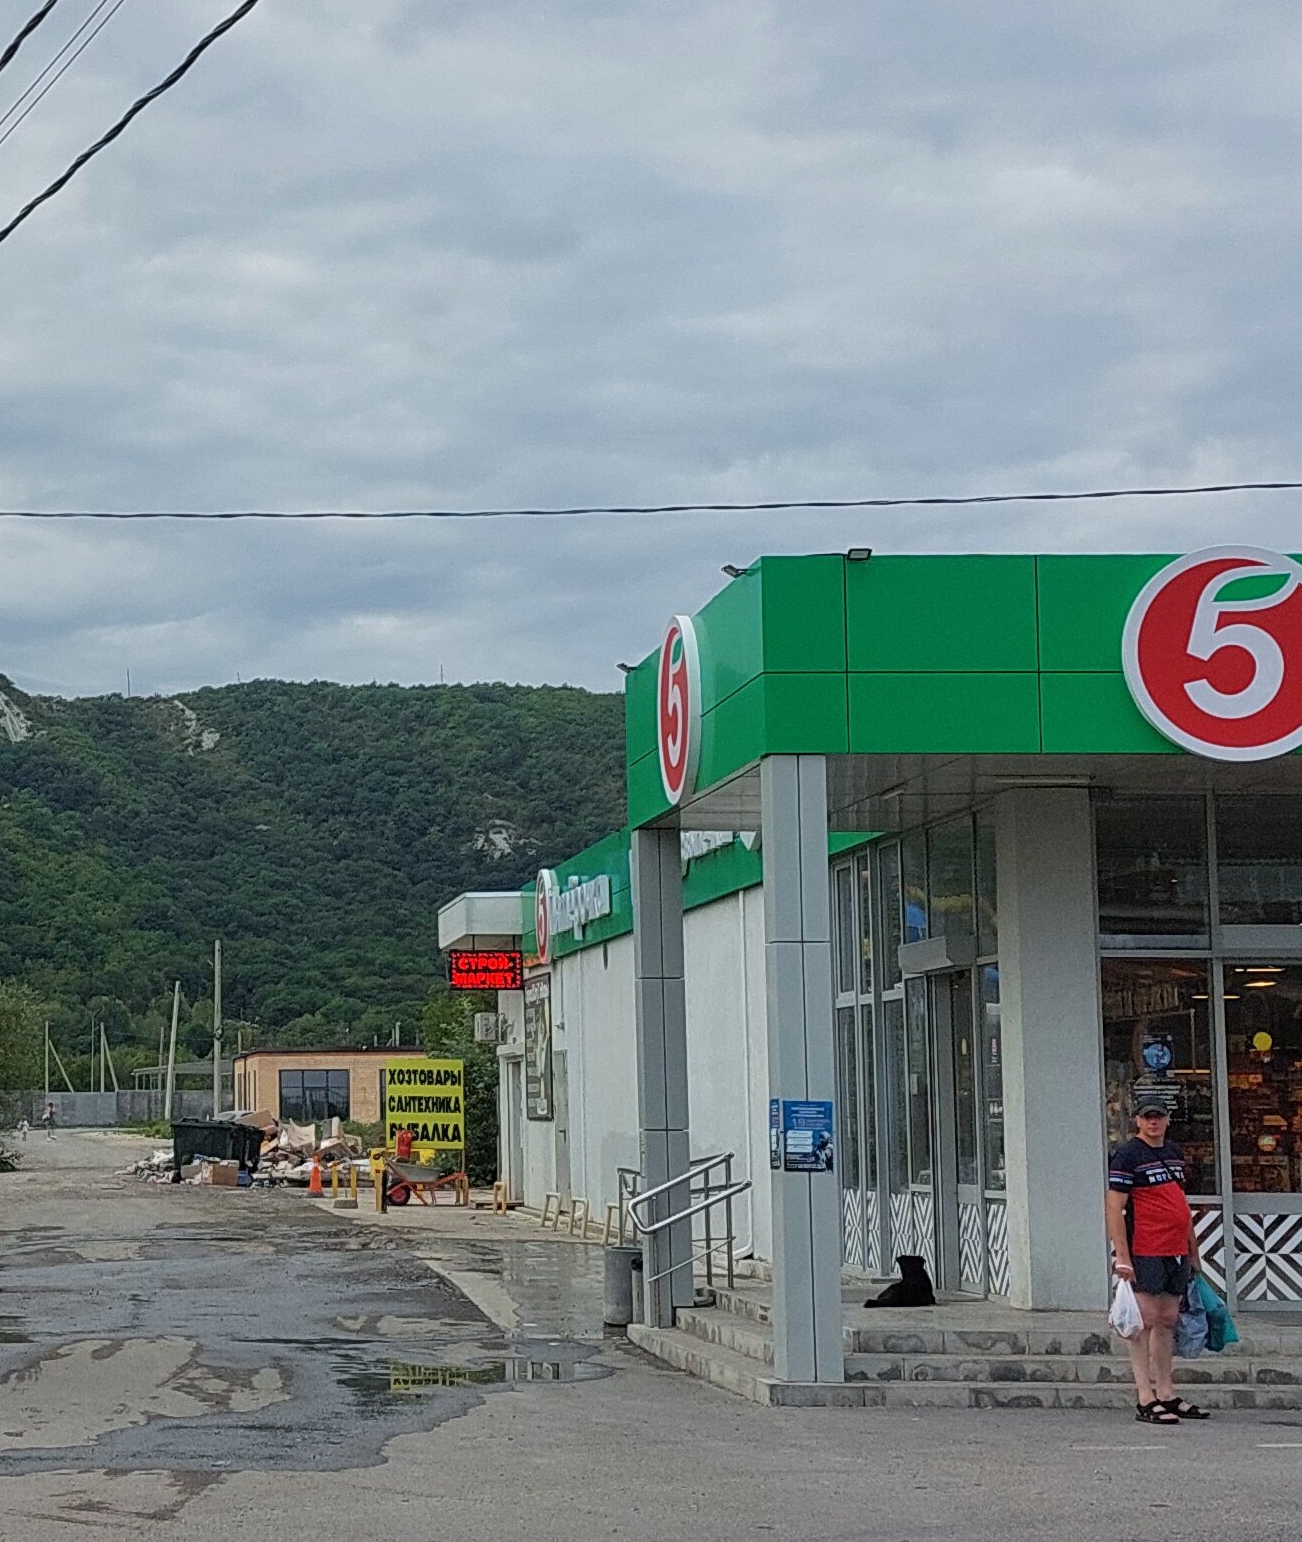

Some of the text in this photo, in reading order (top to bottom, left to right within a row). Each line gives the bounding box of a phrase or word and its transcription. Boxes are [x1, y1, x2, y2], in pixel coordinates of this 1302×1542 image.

[452, 972, 514, 985] МАРКЕТ
[388, 1068, 462, 1087] ХОЗТОВАРЫ
[388, 1095, 462, 1114] САНТЕХНИКА
